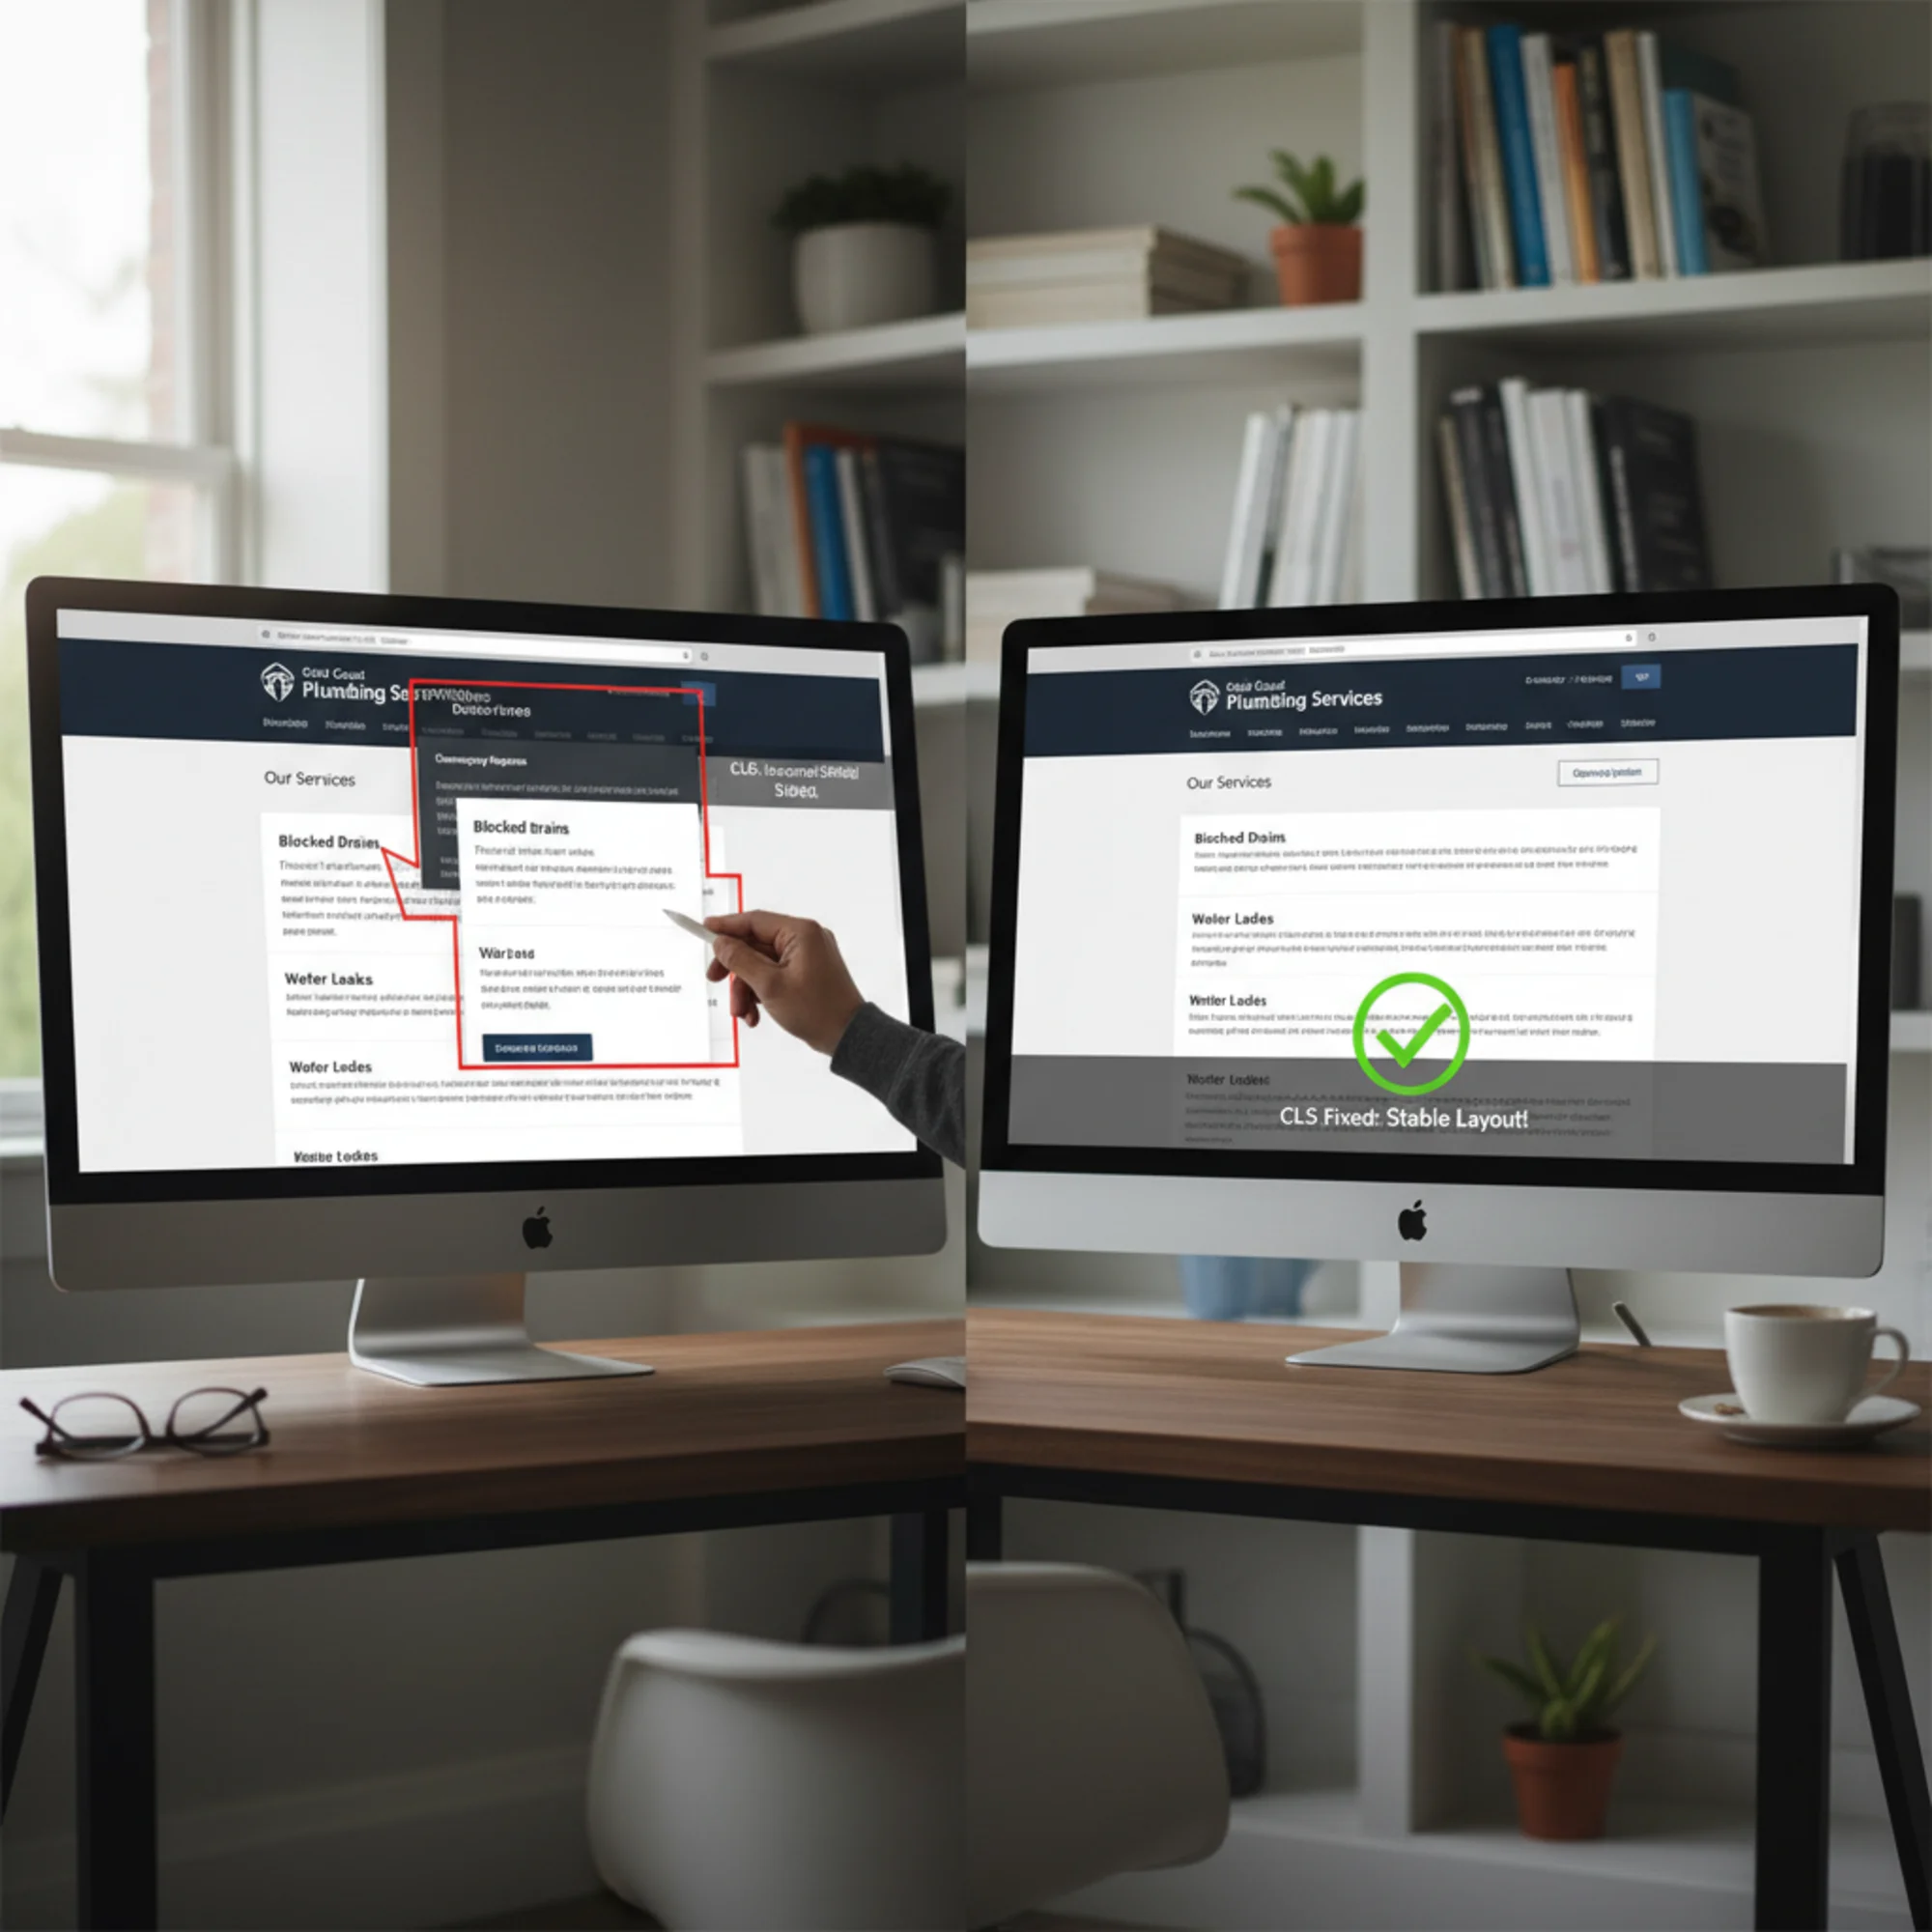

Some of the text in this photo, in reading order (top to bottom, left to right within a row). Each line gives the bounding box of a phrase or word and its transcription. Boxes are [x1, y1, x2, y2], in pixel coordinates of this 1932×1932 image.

[302, 681, 385, 705] Plumbing
[1312, 690, 1383, 706] Services
[264, 770, 355, 787] Our Services
[1186, 776, 1272, 789] Our Services
[472, 820, 526, 834] Blocked
[278, 835, 334, 848] Blocked
[1280, 1107, 1318, 1125] CLS
[1324, 1108, 1379, 1127] Fixed:
[1386, 1107, 1450, 1128] Stable
[1456, 1108, 1528, 1132] Layout!
